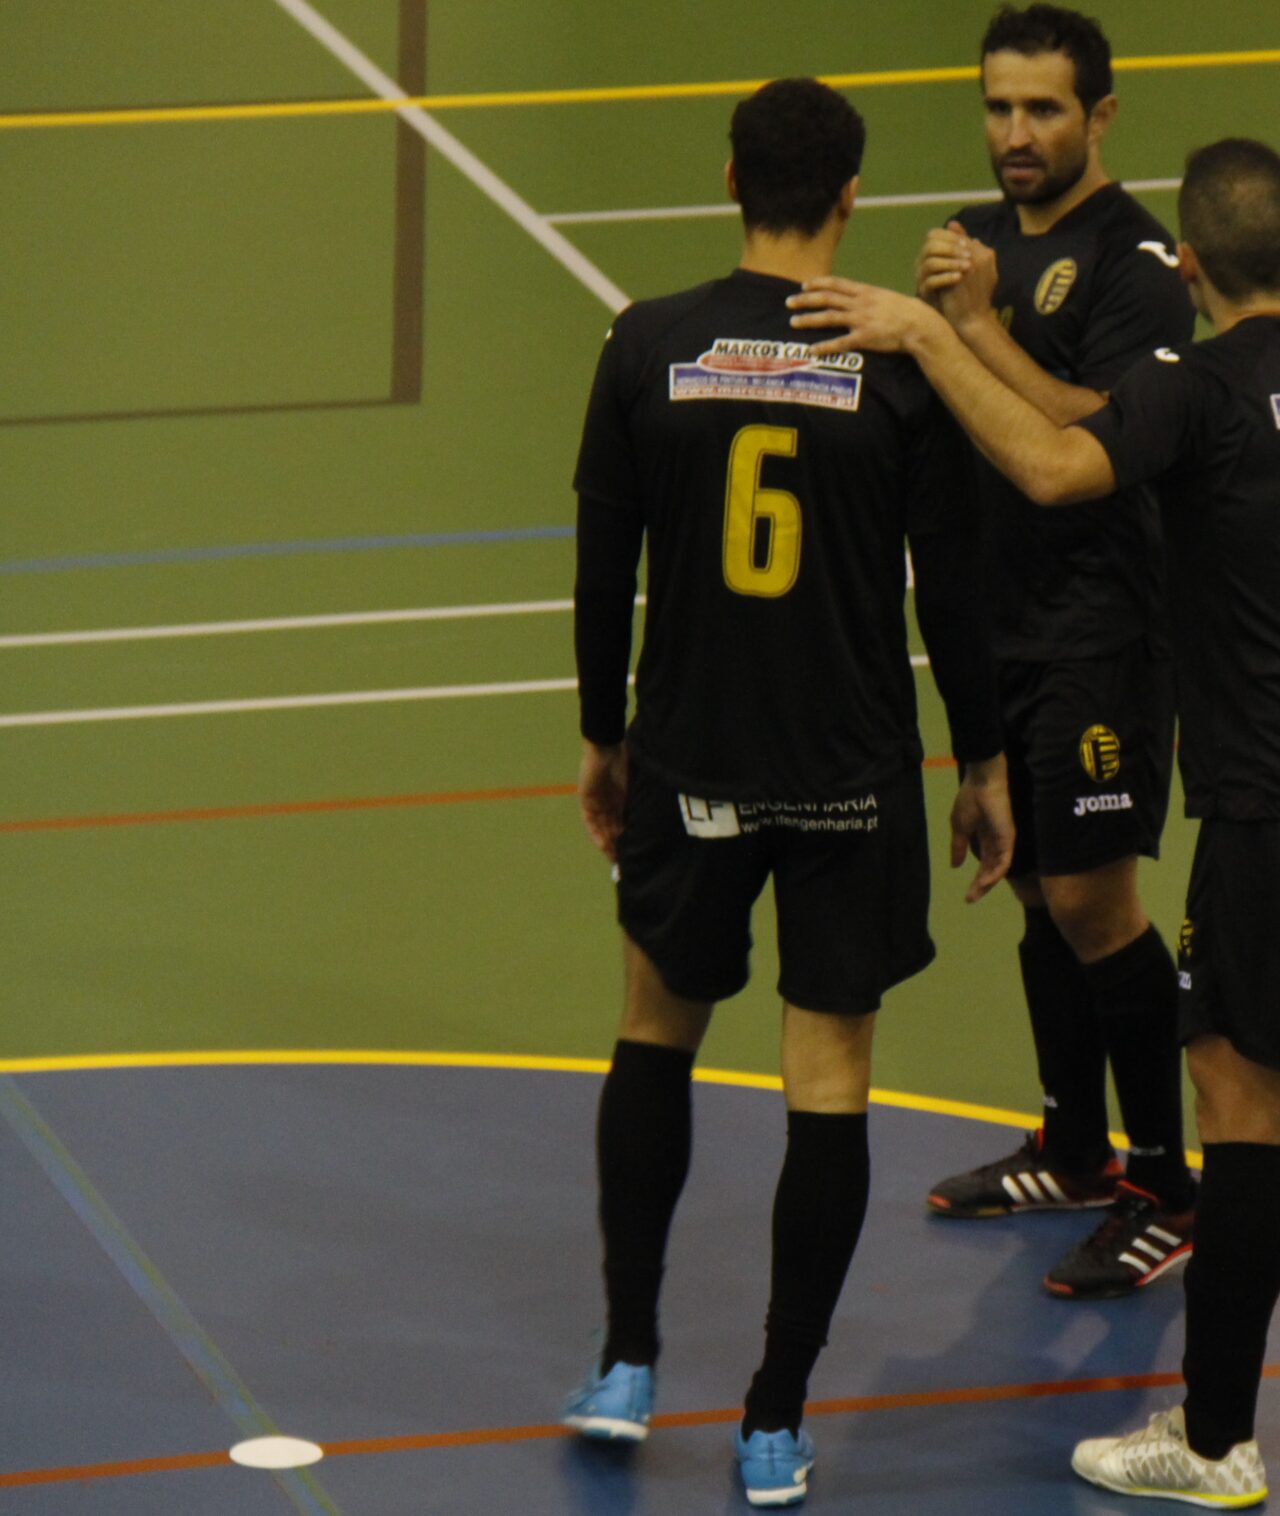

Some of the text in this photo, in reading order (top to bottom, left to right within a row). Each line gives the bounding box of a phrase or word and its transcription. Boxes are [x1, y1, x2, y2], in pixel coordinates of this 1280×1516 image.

[714, 341, 778, 357] MARCOS
[722, 423, 803, 598] 6
[684, 795, 725, 821] LF
[738, 793, 878, 815] ENGENHARIA
